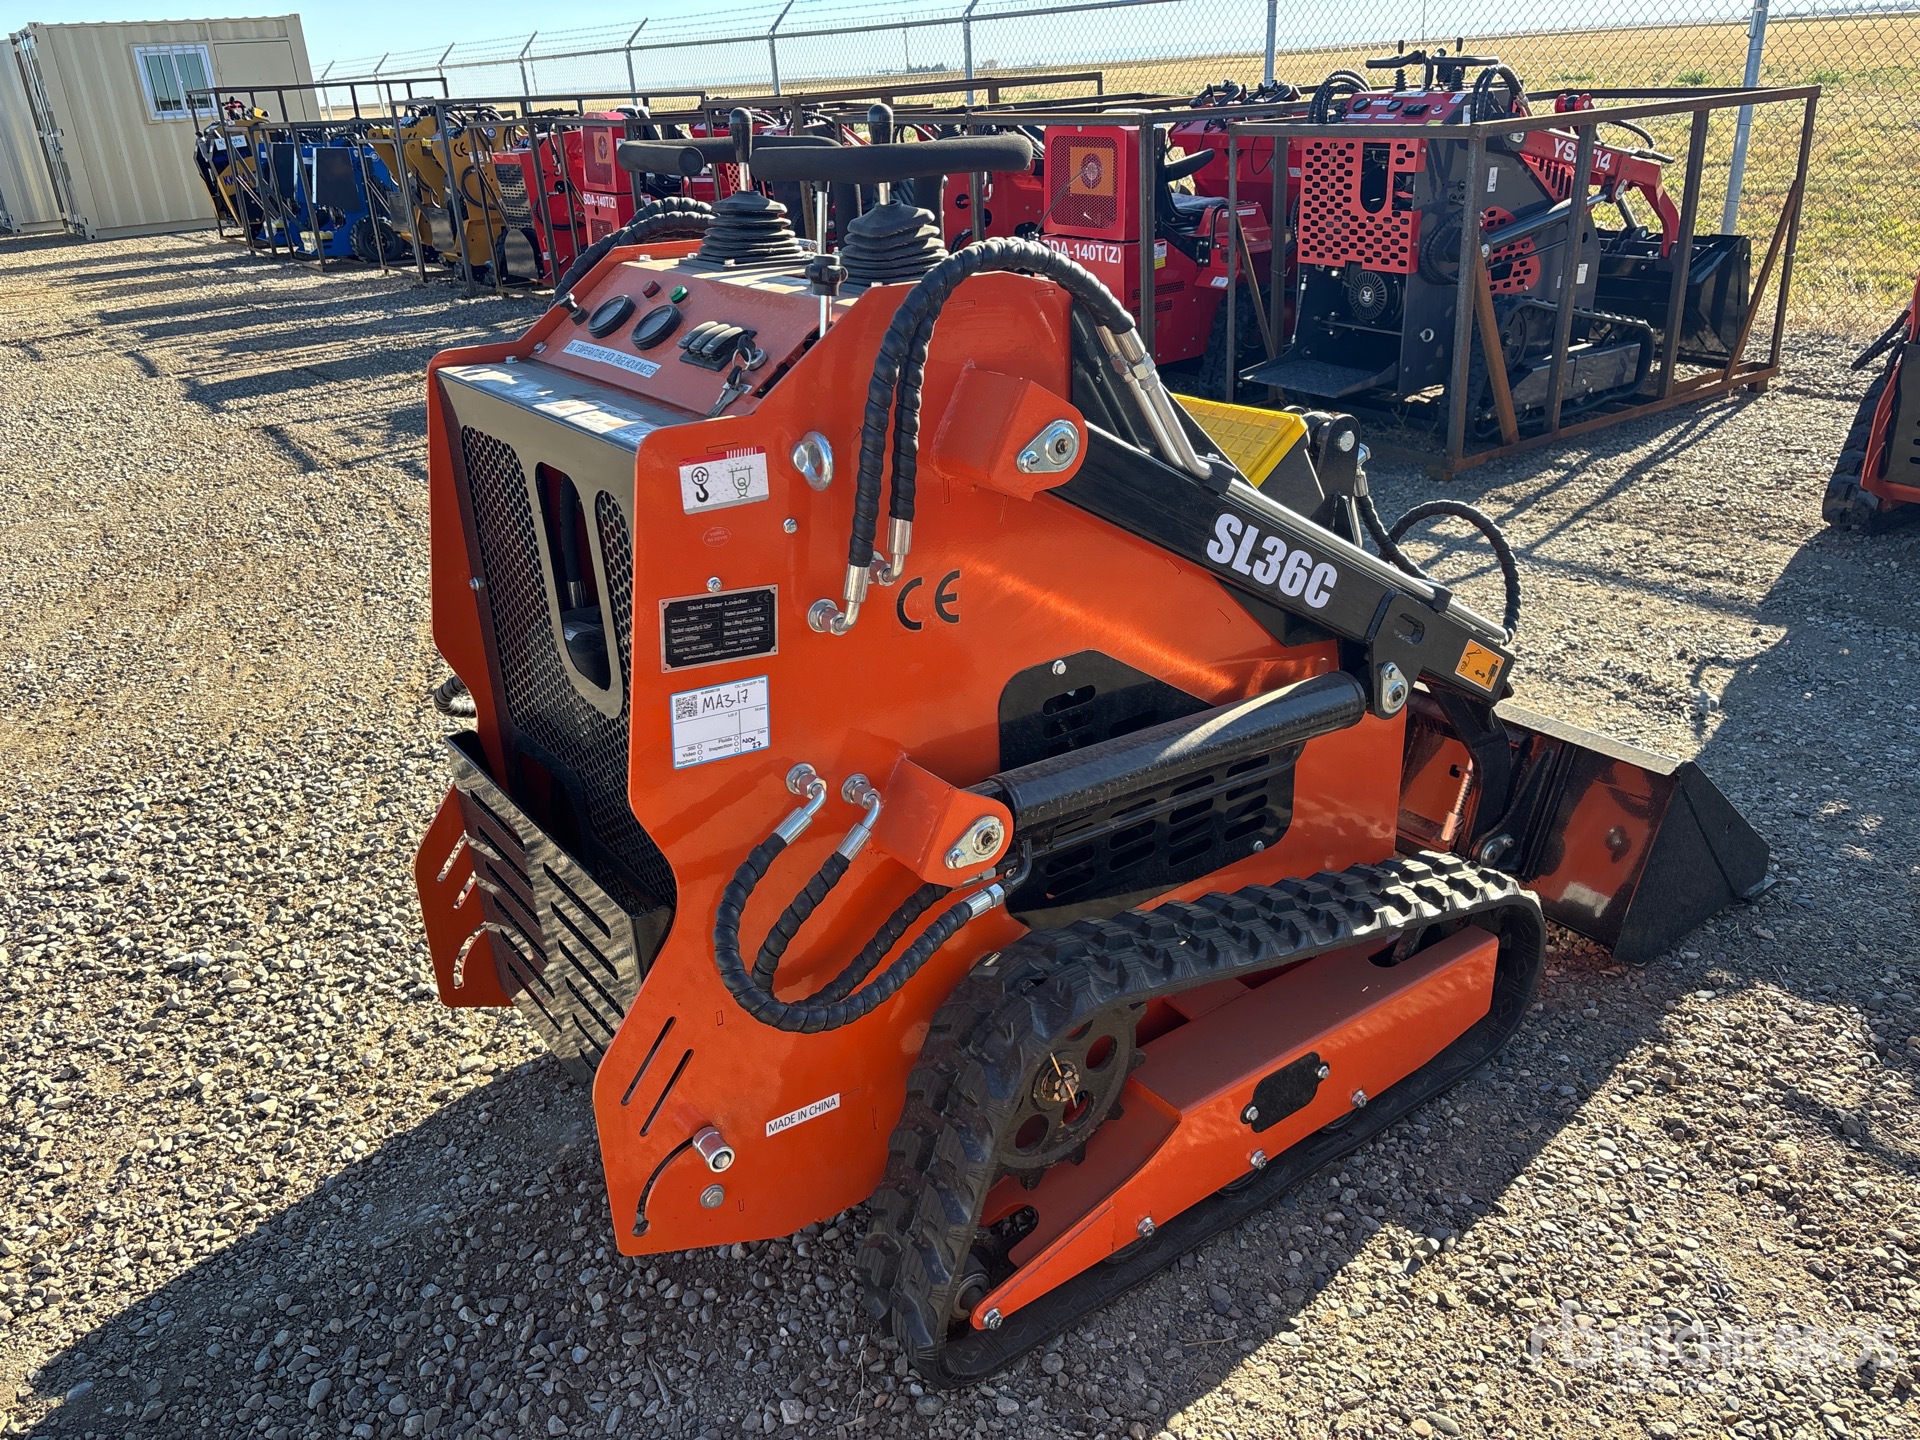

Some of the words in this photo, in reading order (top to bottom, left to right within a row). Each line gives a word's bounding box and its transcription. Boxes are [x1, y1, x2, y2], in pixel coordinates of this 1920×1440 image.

[1206, 513, 1338, 609] SL36C
[896, 570, 960, 631] CE
[708, 743, 733, 752] Inspection
[768, 1113, 796, 1133] MADE
[797, 1109, 807, 1121] IN
[808, 1098, 837, 1116] CHINA
